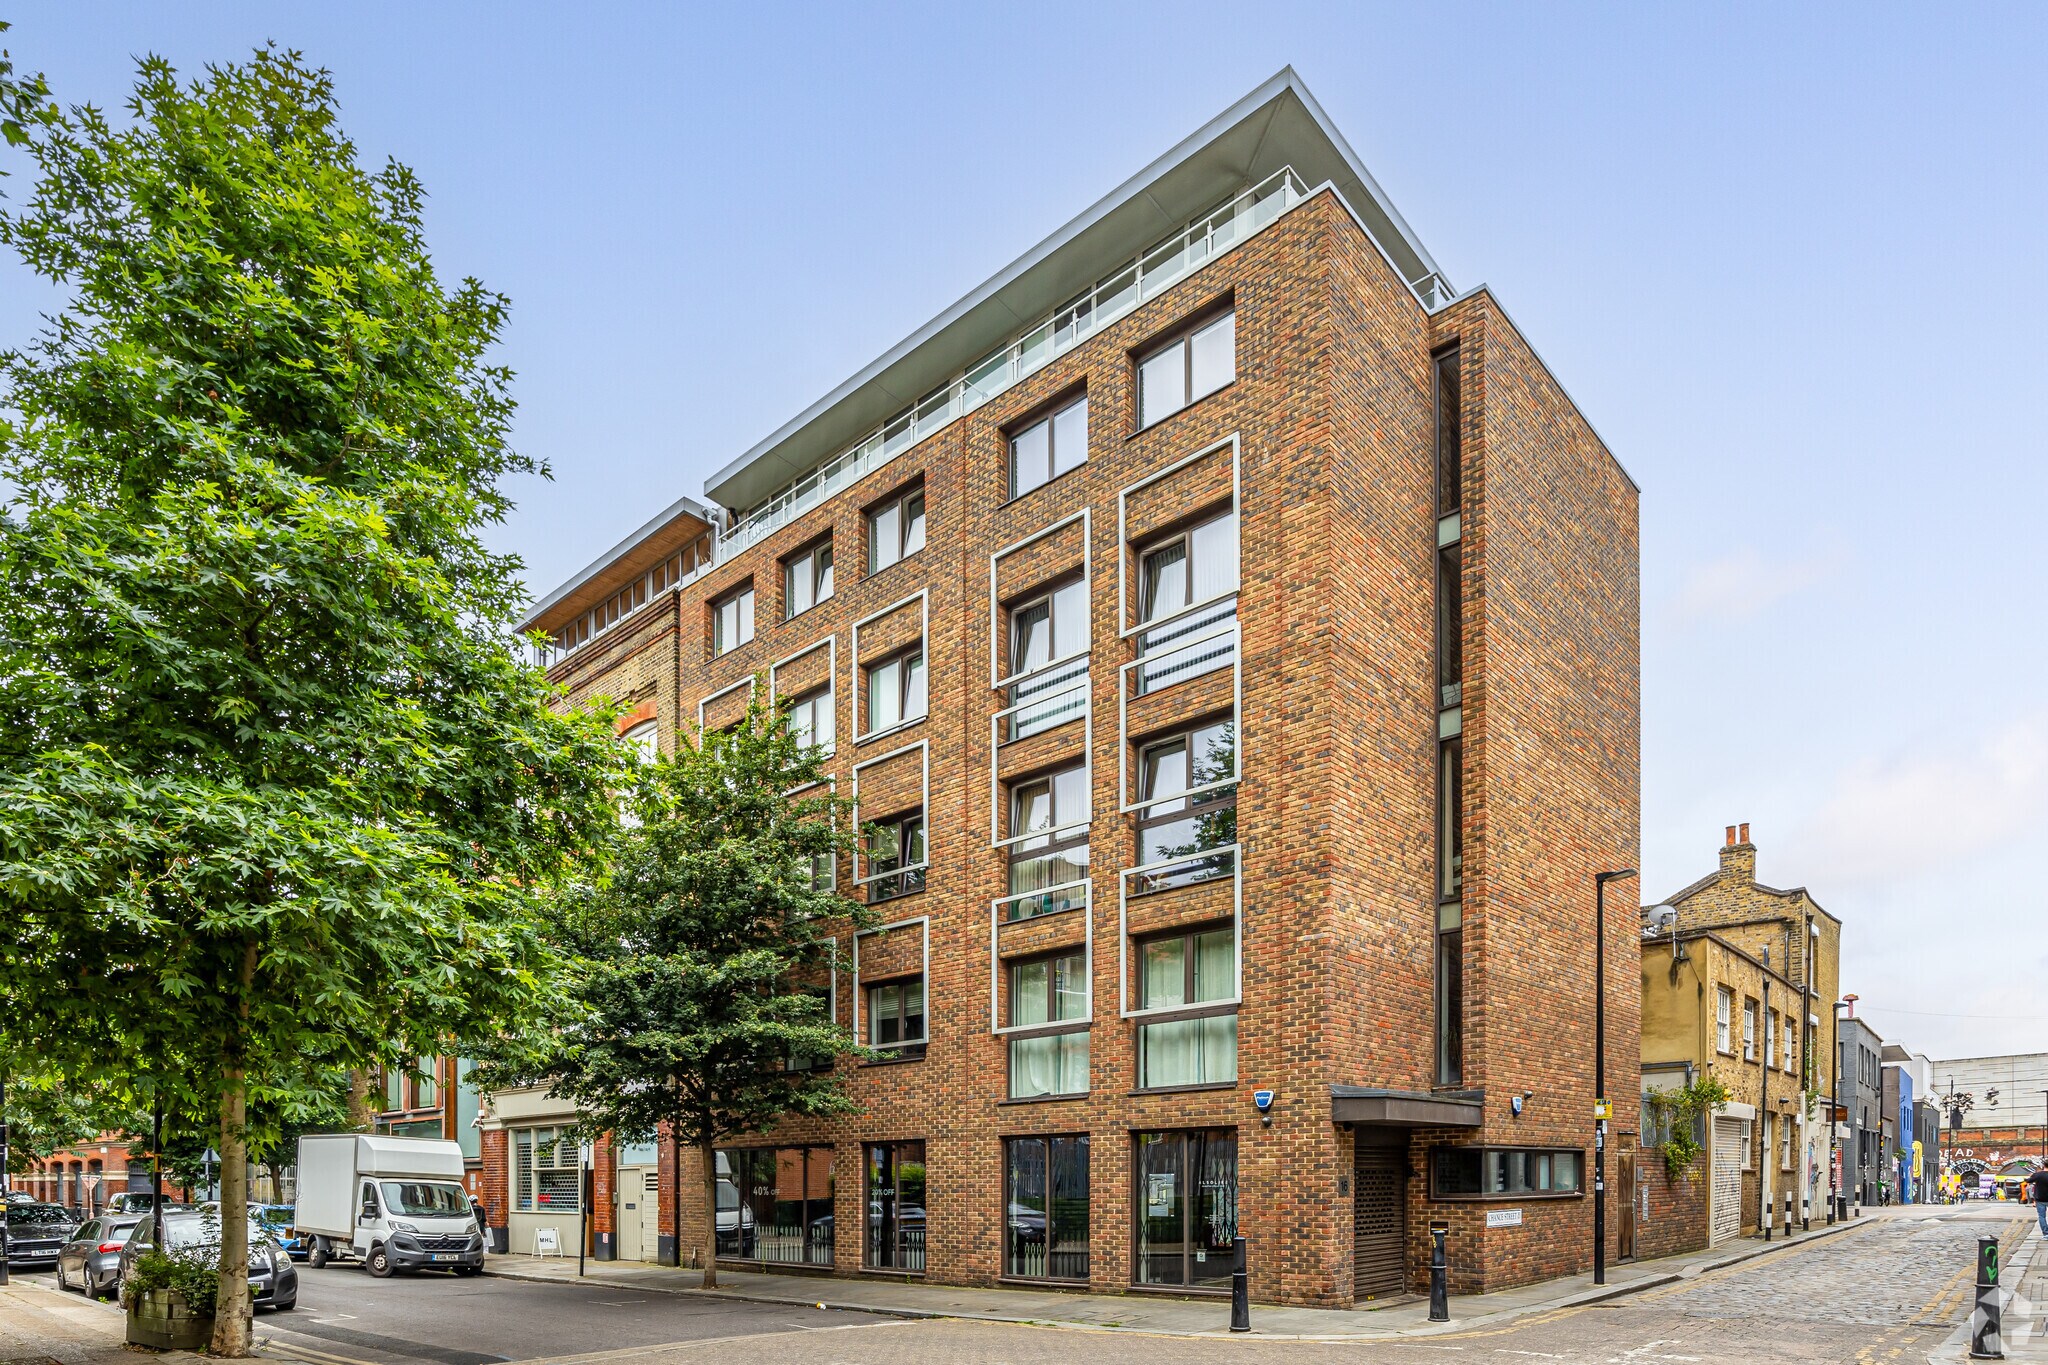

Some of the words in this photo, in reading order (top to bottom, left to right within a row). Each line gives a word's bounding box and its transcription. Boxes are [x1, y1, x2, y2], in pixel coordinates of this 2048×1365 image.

[1341, 1180, 1348, 1192] 16
[753, 1186, 769, 1196] 40%
[883, 1188, 895, 1196] OFF
[1504, 1212, 1517, 1220] STREET
